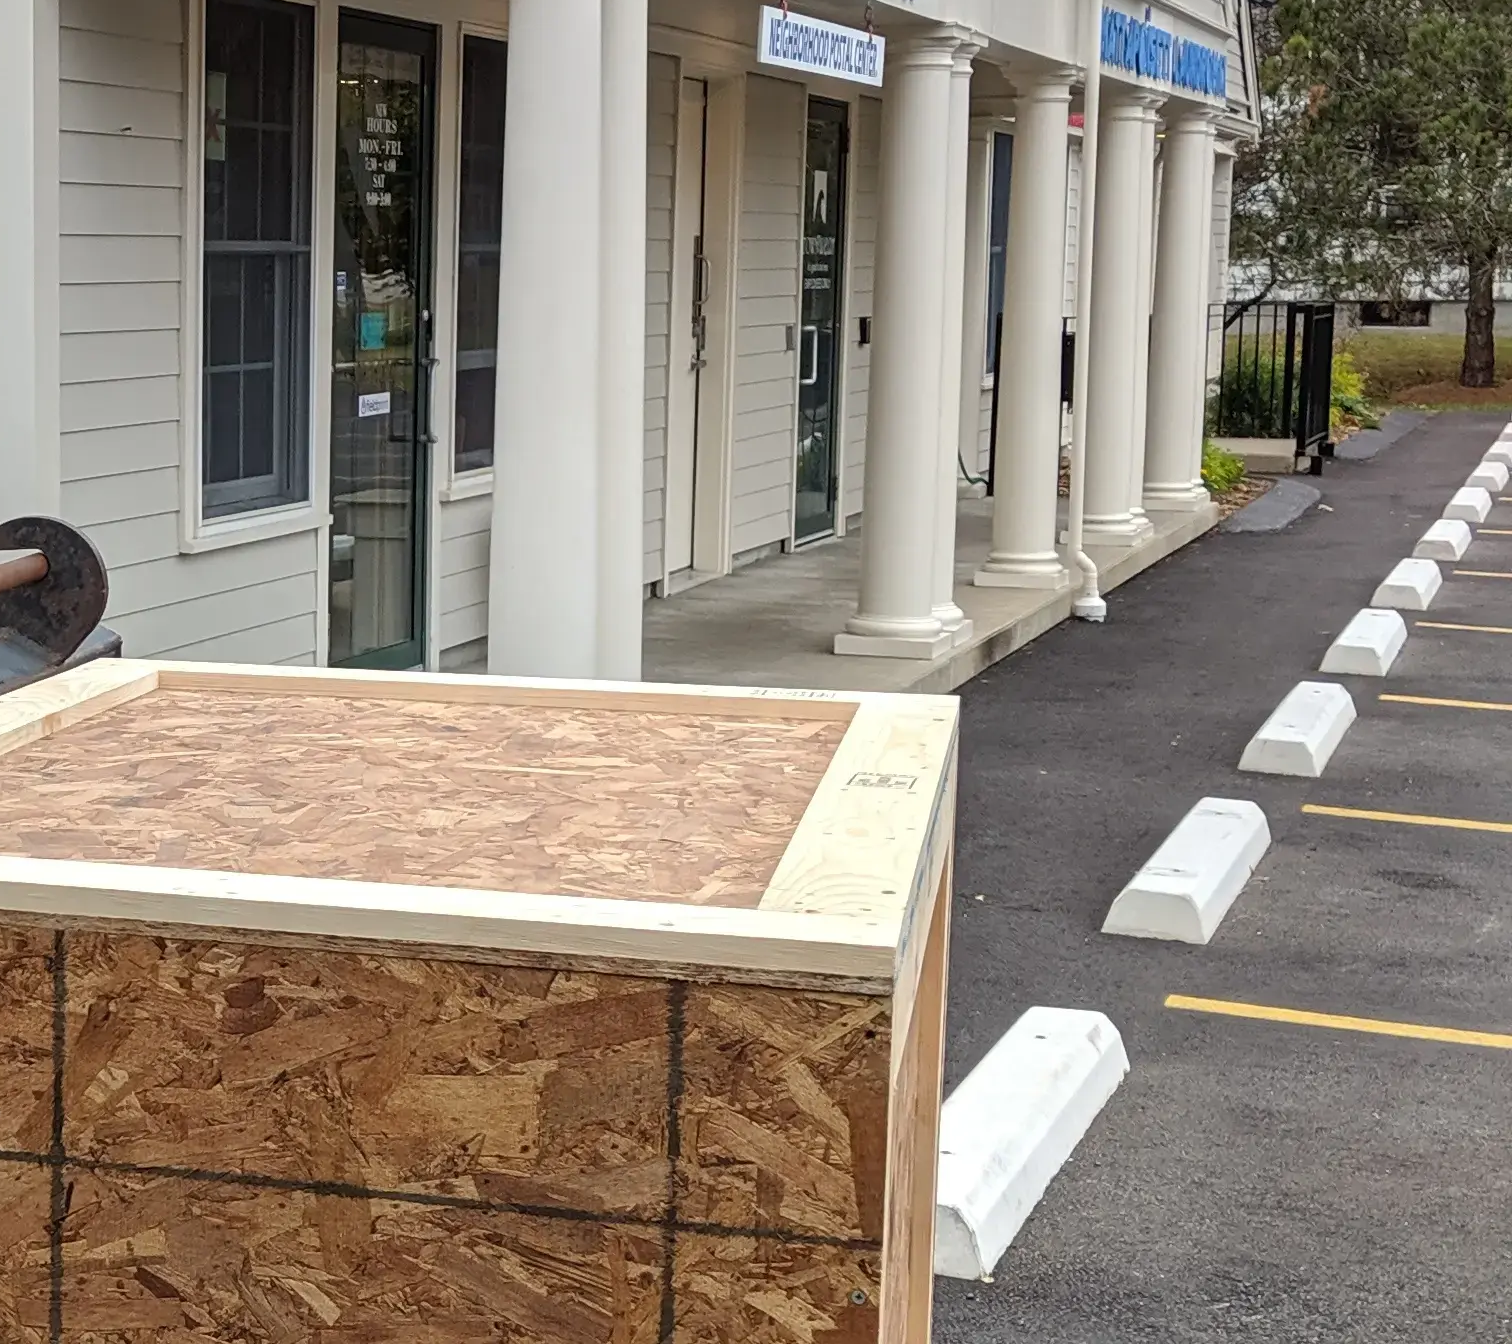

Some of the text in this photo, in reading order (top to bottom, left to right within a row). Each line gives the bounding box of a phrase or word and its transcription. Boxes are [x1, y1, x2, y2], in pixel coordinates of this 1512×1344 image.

[769, 17, 878, 77] NEIGHBORHOOD POSTAL CENTER
[366, 117, 398, 134] HOURS
